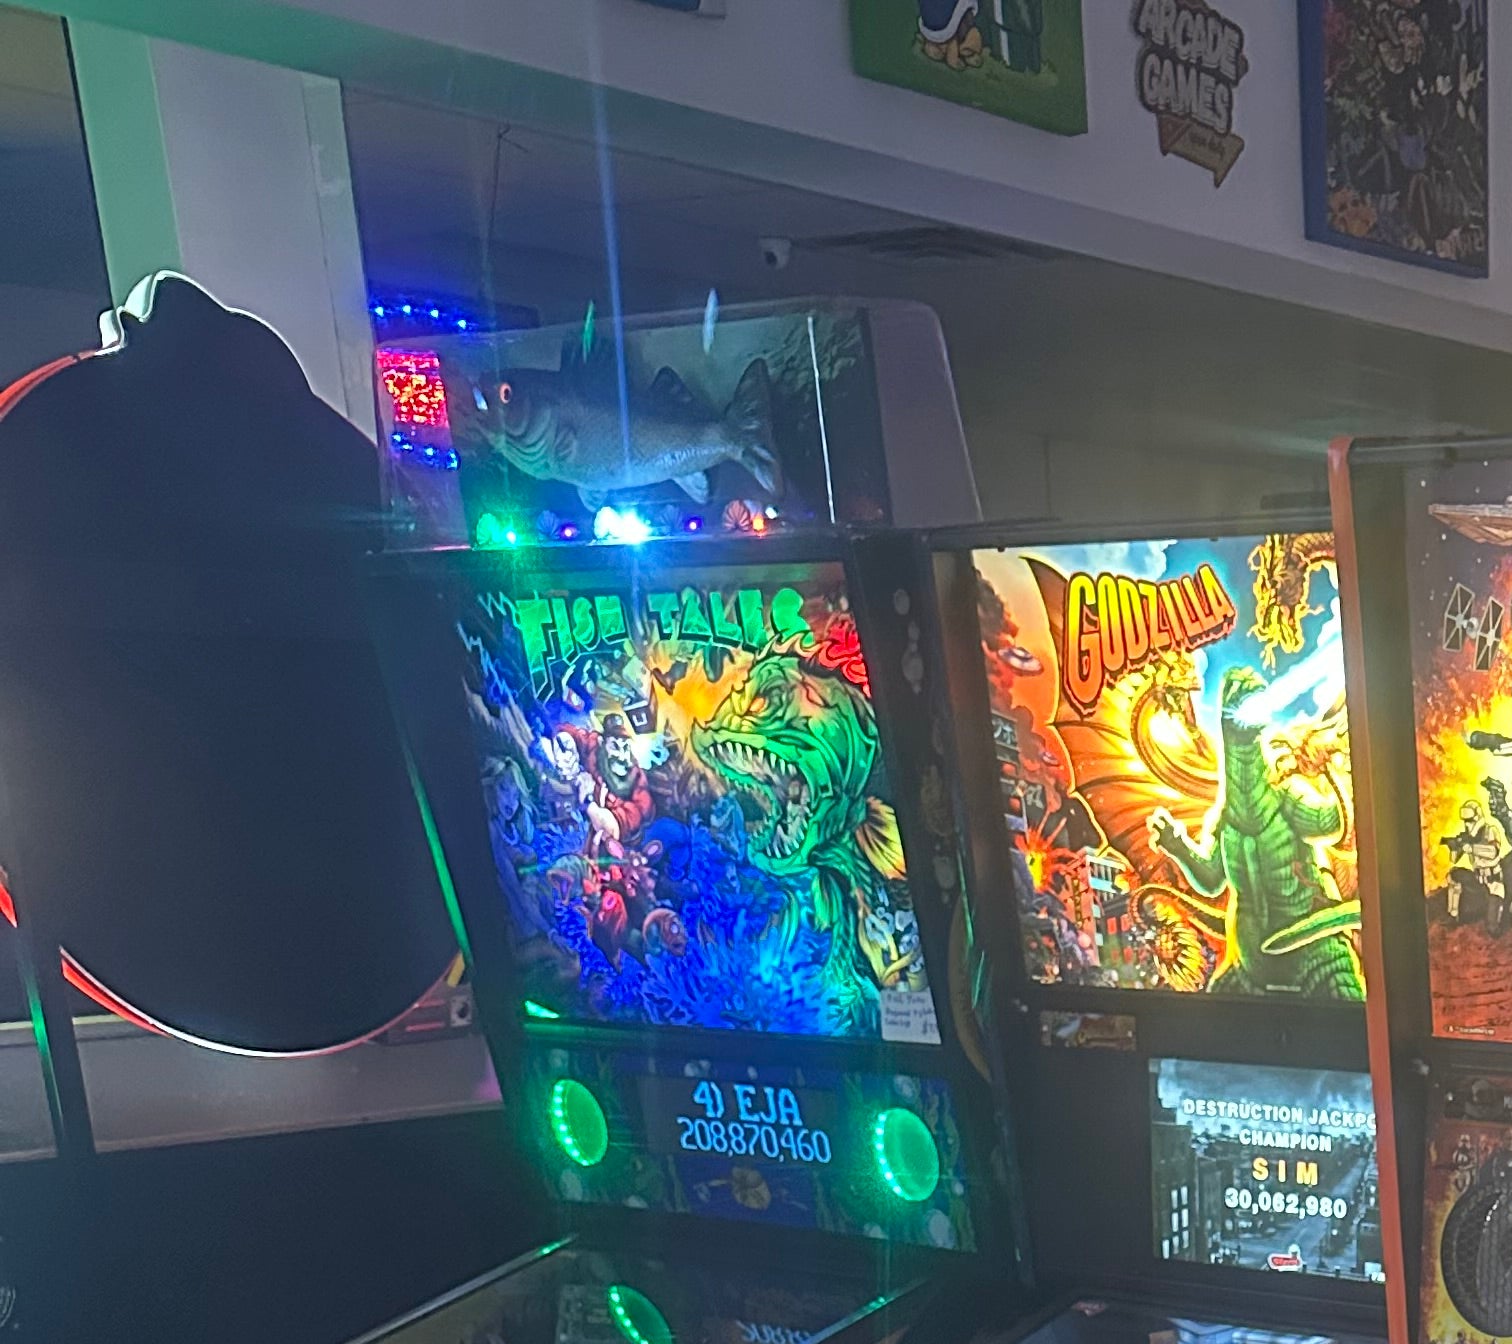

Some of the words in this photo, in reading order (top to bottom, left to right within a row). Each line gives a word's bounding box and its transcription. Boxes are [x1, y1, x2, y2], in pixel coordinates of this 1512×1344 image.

[1138, 0, 1240, 82] ARCADE
[1143, 53, 1231, 135] GAMES
[512, 595, 630, 692] FISH
[647, 588, 815, 650] TALES
[1066, 564, 1236, 705] GODZILLA
[733, 1083, 803, 1126] EJA
[1183, 1099, 1303, 1122] DESTRUCTION
[1308, 1110, 1377, 1130] JACKPO
[676, 1117, 832, 1164] 208,870,460
[1239, 1129, 1332, 1152] CHAMPION
[1225, 1187, 1348, 1219] 30,062,980
